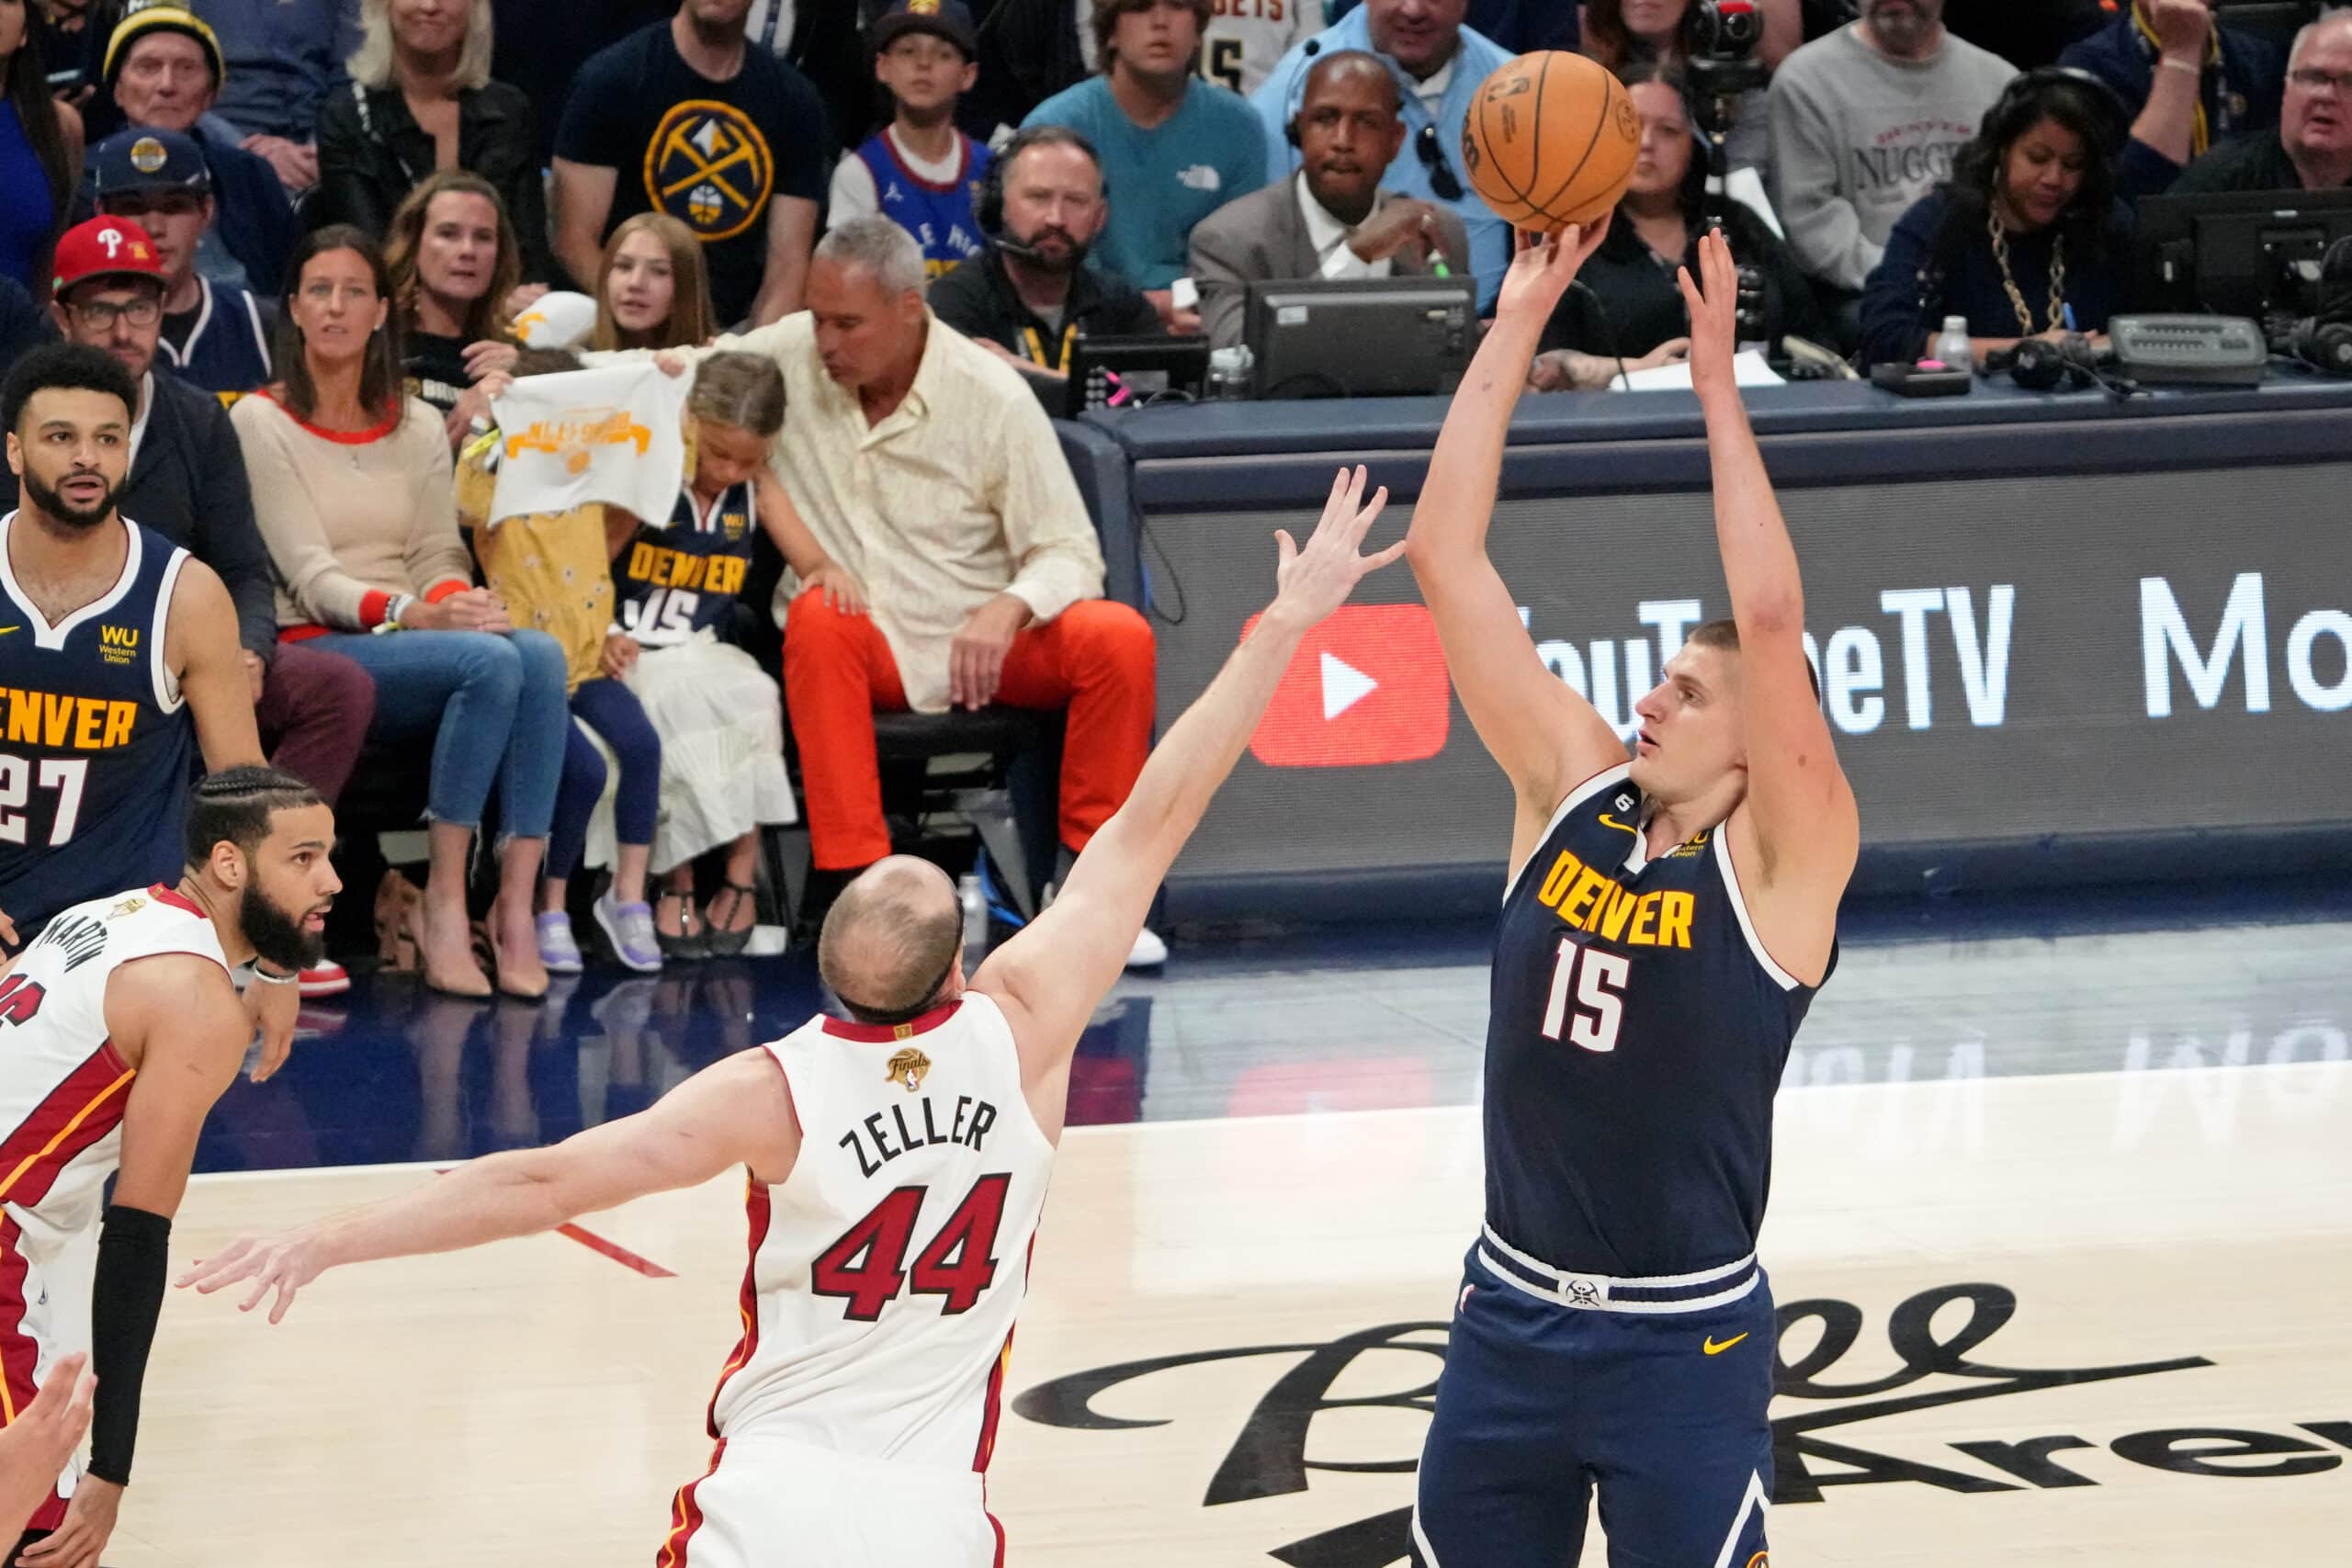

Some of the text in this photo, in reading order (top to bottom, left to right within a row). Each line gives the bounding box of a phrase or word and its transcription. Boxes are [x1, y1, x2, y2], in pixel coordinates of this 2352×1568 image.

[628, 541, 749, 594] DENVER
[98, 644, 137, 658] Western
[101, 625, 139, 647] WU
[104, 654, 130, 665] Union
[1519, 583, 2016, 743] ouTeTV
[0, 686, 138, 750] NVER
[1614, 793, 1635, 812] 6
[1537, 849, 1695, 950] DENVER
[36, 914, 108, 974] MARTIN
[1542, 937, 1632, 1054] 15
[885, 1052, 932, 1082] Finals
[838, 1095, 997, 1179] ZELLER
[810, 1171, 1013, 1323] 44
